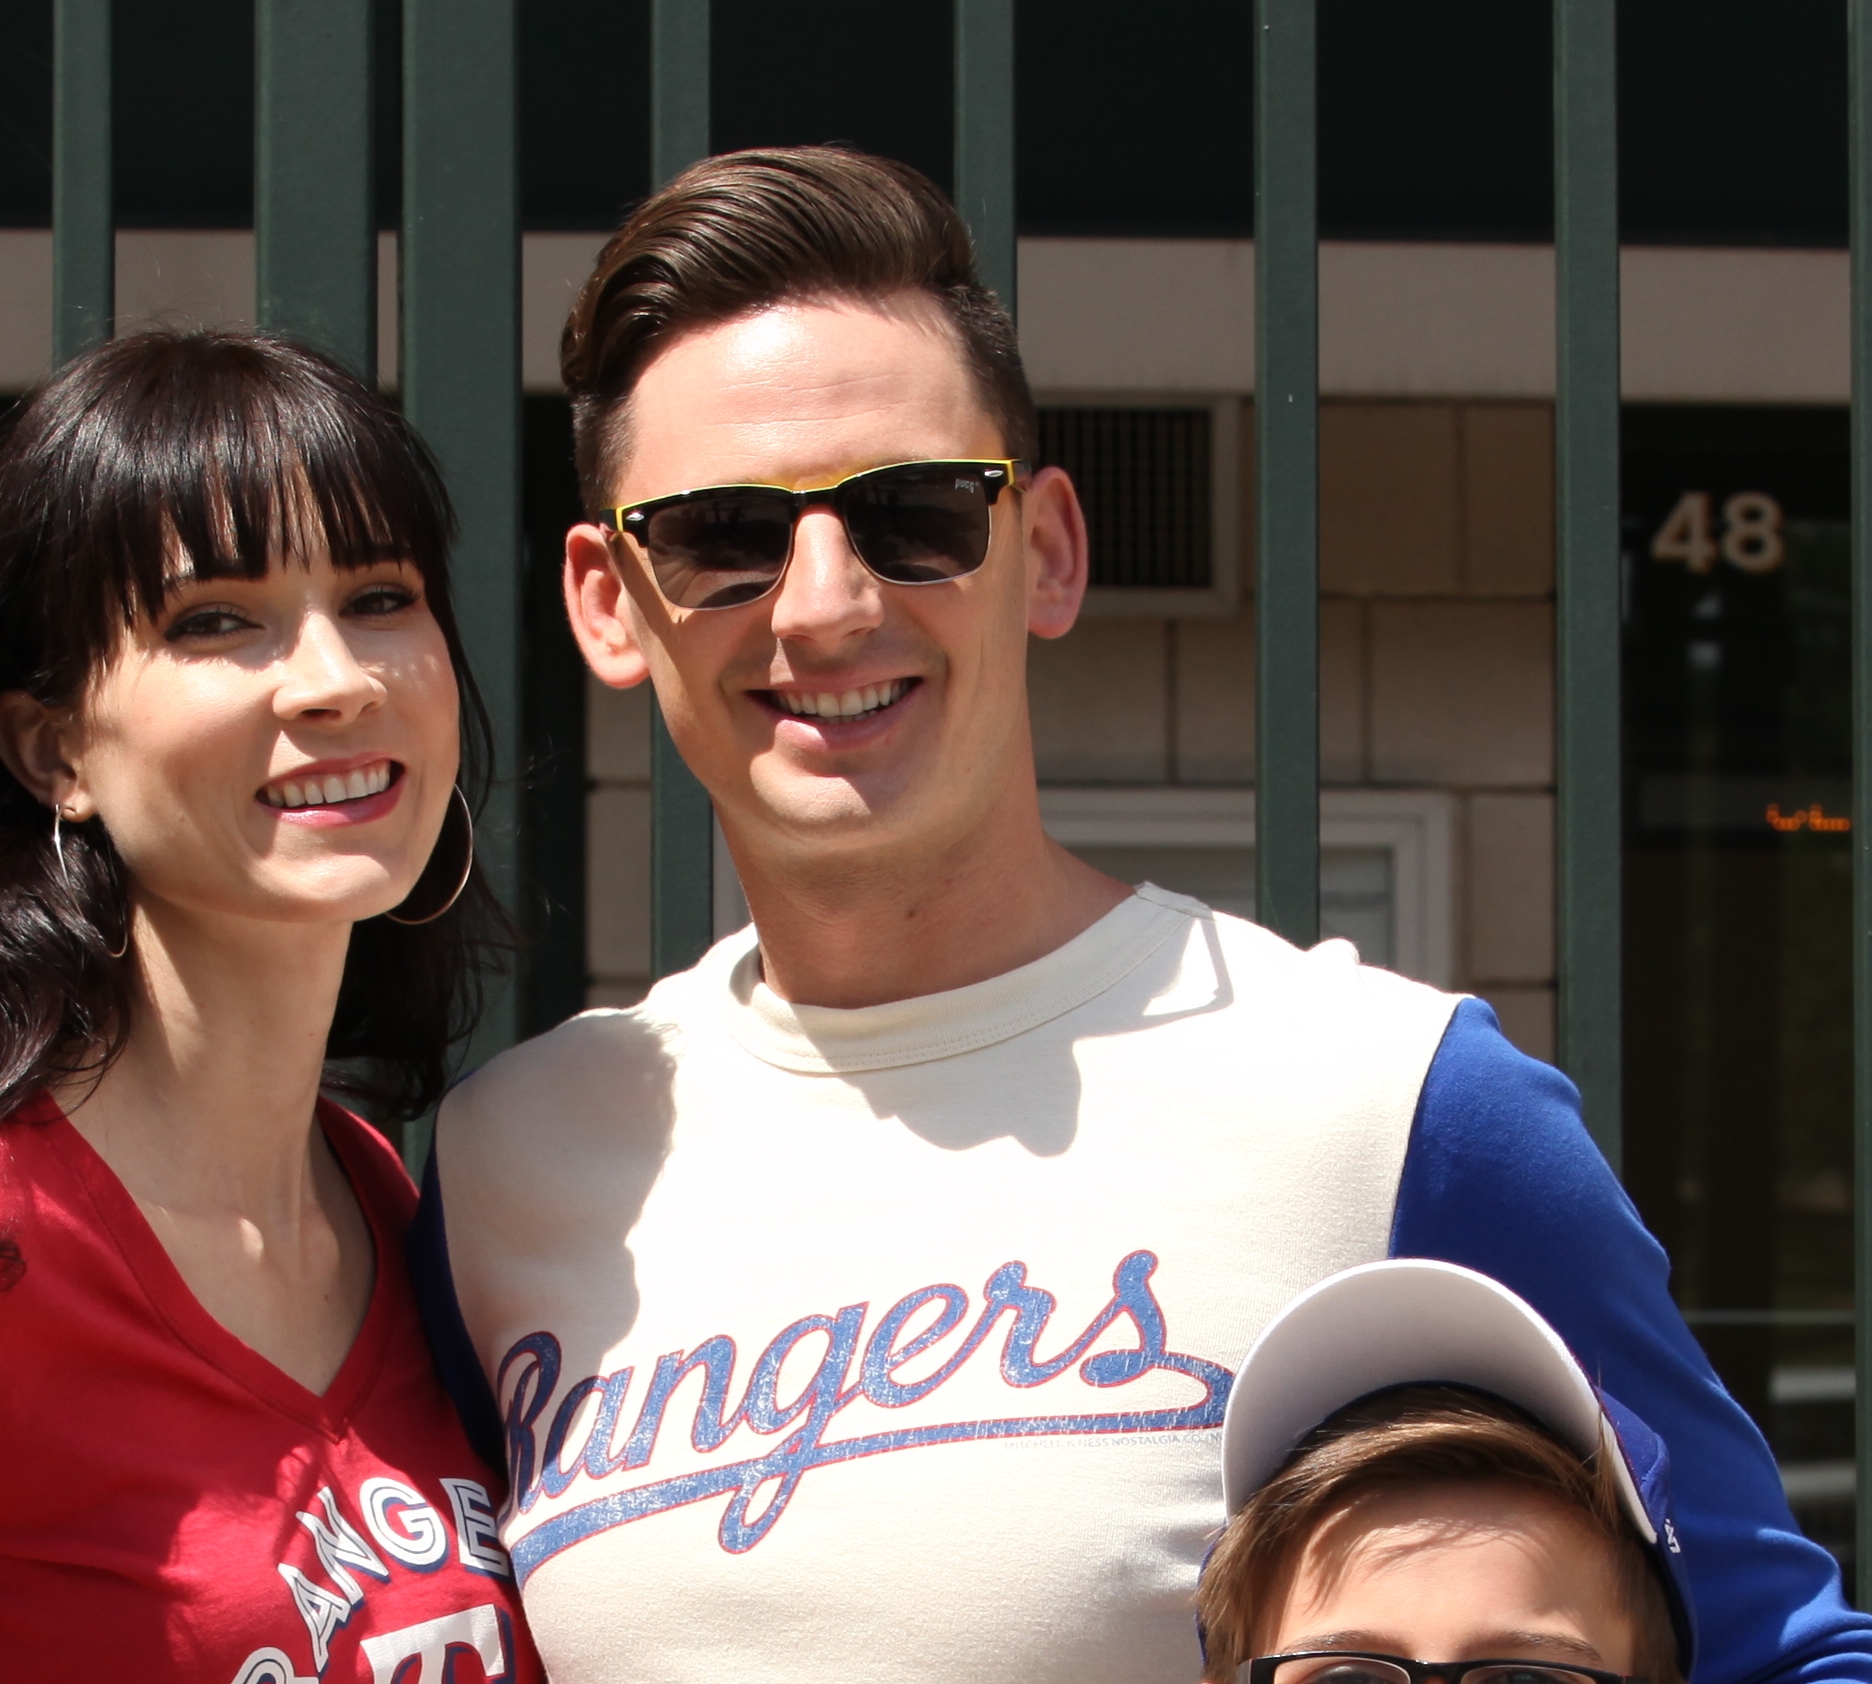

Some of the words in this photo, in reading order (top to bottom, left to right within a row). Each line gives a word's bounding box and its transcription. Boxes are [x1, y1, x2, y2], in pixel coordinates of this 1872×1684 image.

[1648, 490, 1787, 575] 48
[498, 1250, 1203, 1553] Rangers
[1111, 1434, 1181, 1446] NOSTALGIA
